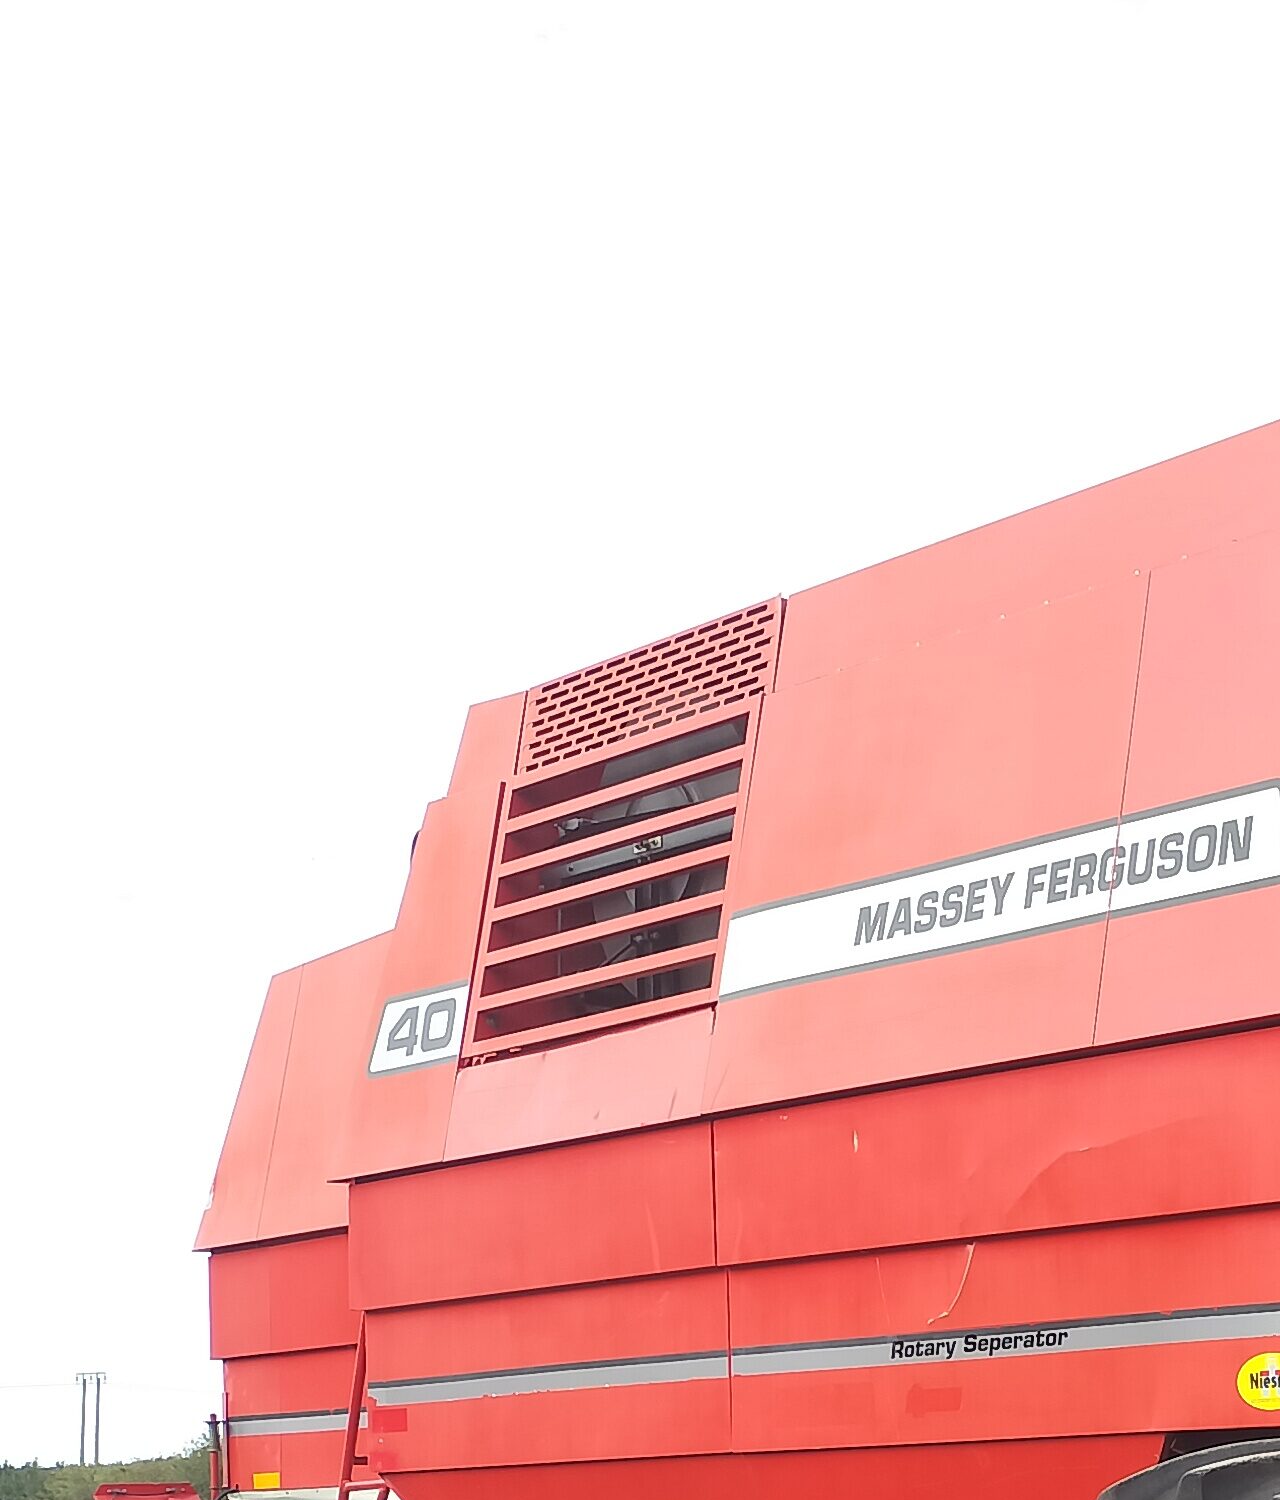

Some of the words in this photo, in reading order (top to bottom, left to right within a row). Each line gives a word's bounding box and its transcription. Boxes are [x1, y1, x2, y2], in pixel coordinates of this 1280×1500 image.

[853, 871, 1015, 946] MASSEY
[1024, 815, 1254, 909] FERGUSON
[386, 998, 457, 1056] 40
[890, 1340, 957, 1359] Rotary
[963, 1331, 1069, 1356] Seperator
